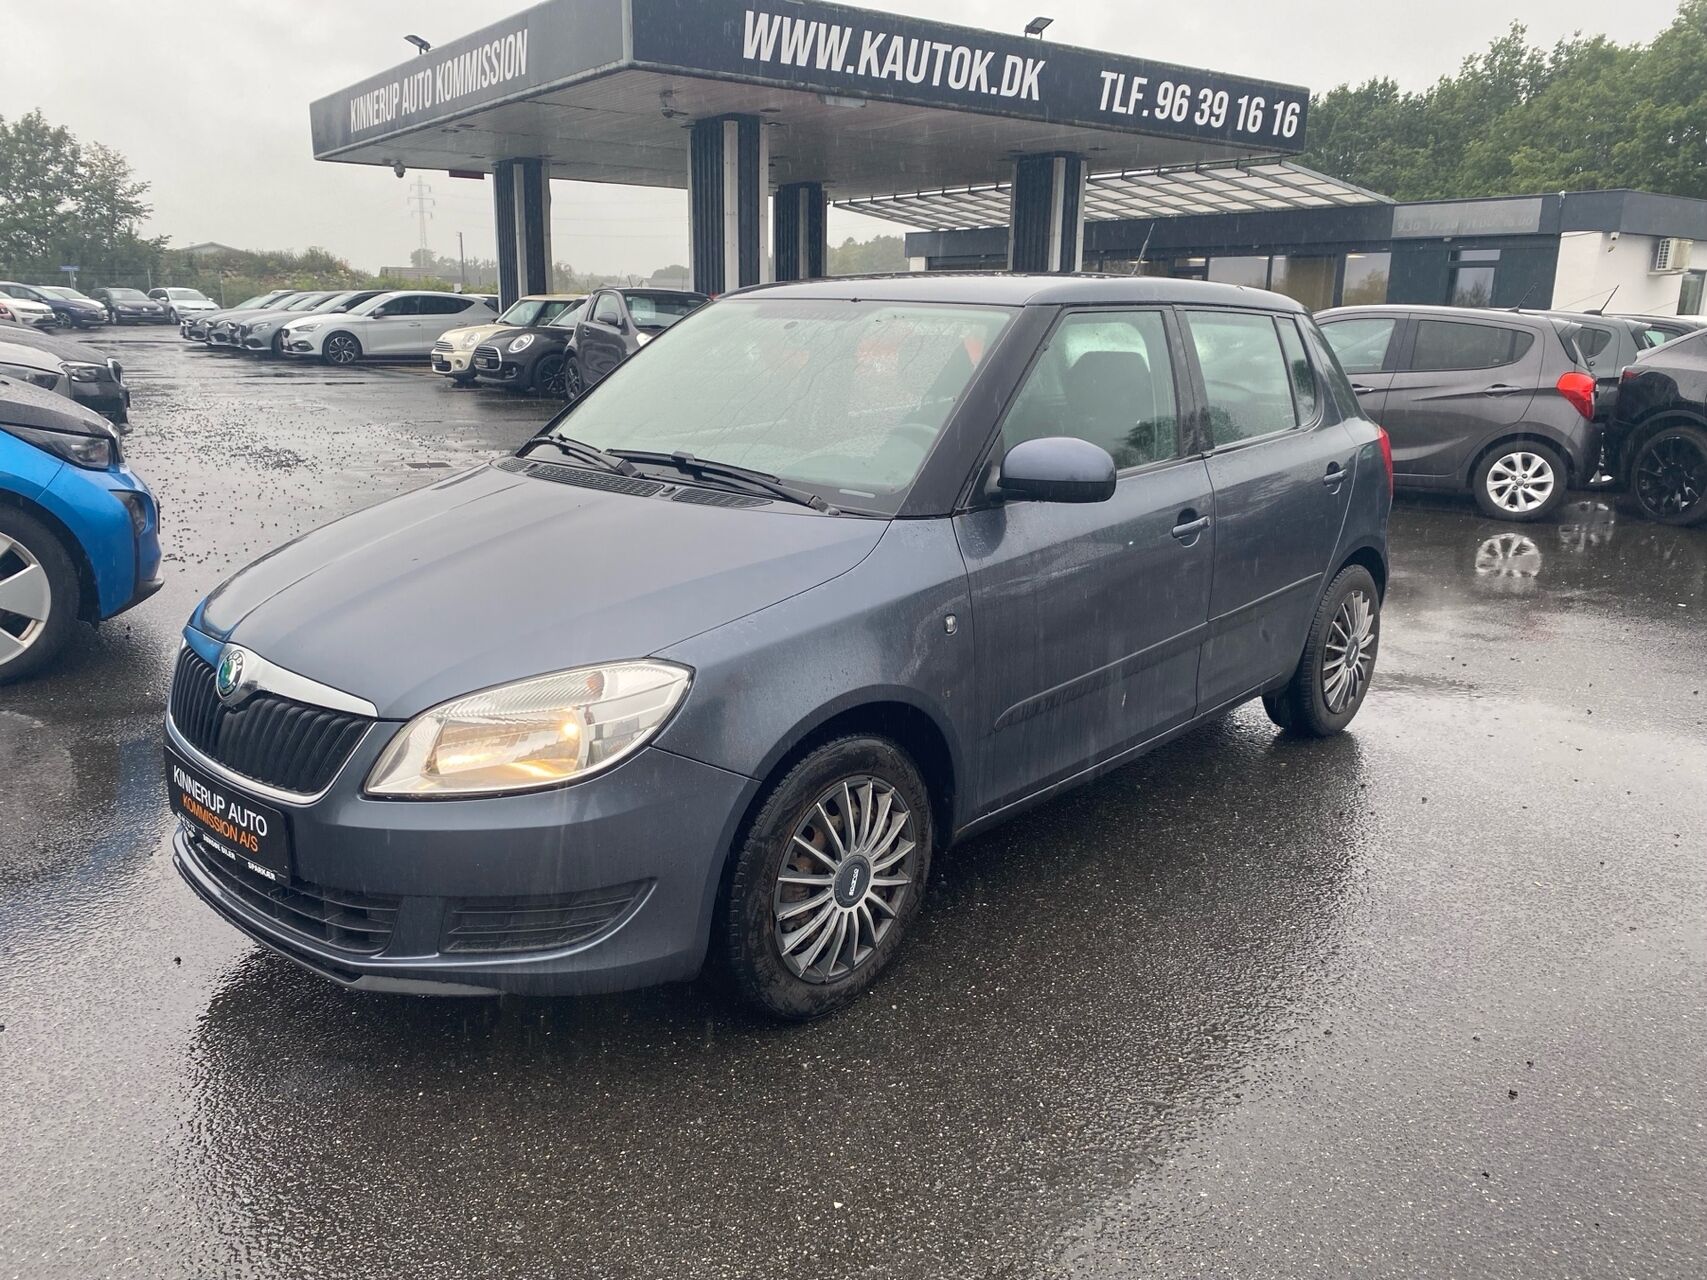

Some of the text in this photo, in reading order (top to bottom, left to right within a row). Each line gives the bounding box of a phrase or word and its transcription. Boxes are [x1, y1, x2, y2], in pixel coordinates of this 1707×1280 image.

[350, 28, 528, 134] KINNERUP AUTO KOMMISSION
[743, 9, 1046, 102] WWW.KAUTOK.DK
[1100, 70, 1301, 138] TLF. 96 39 16 16
[173, 764, 225, 814] KINNERUP
[228, 802, 268, 837] AUTO
[182, 792, 238, 842] KOMMISSION
[239, 829, 259, 853] A/S
